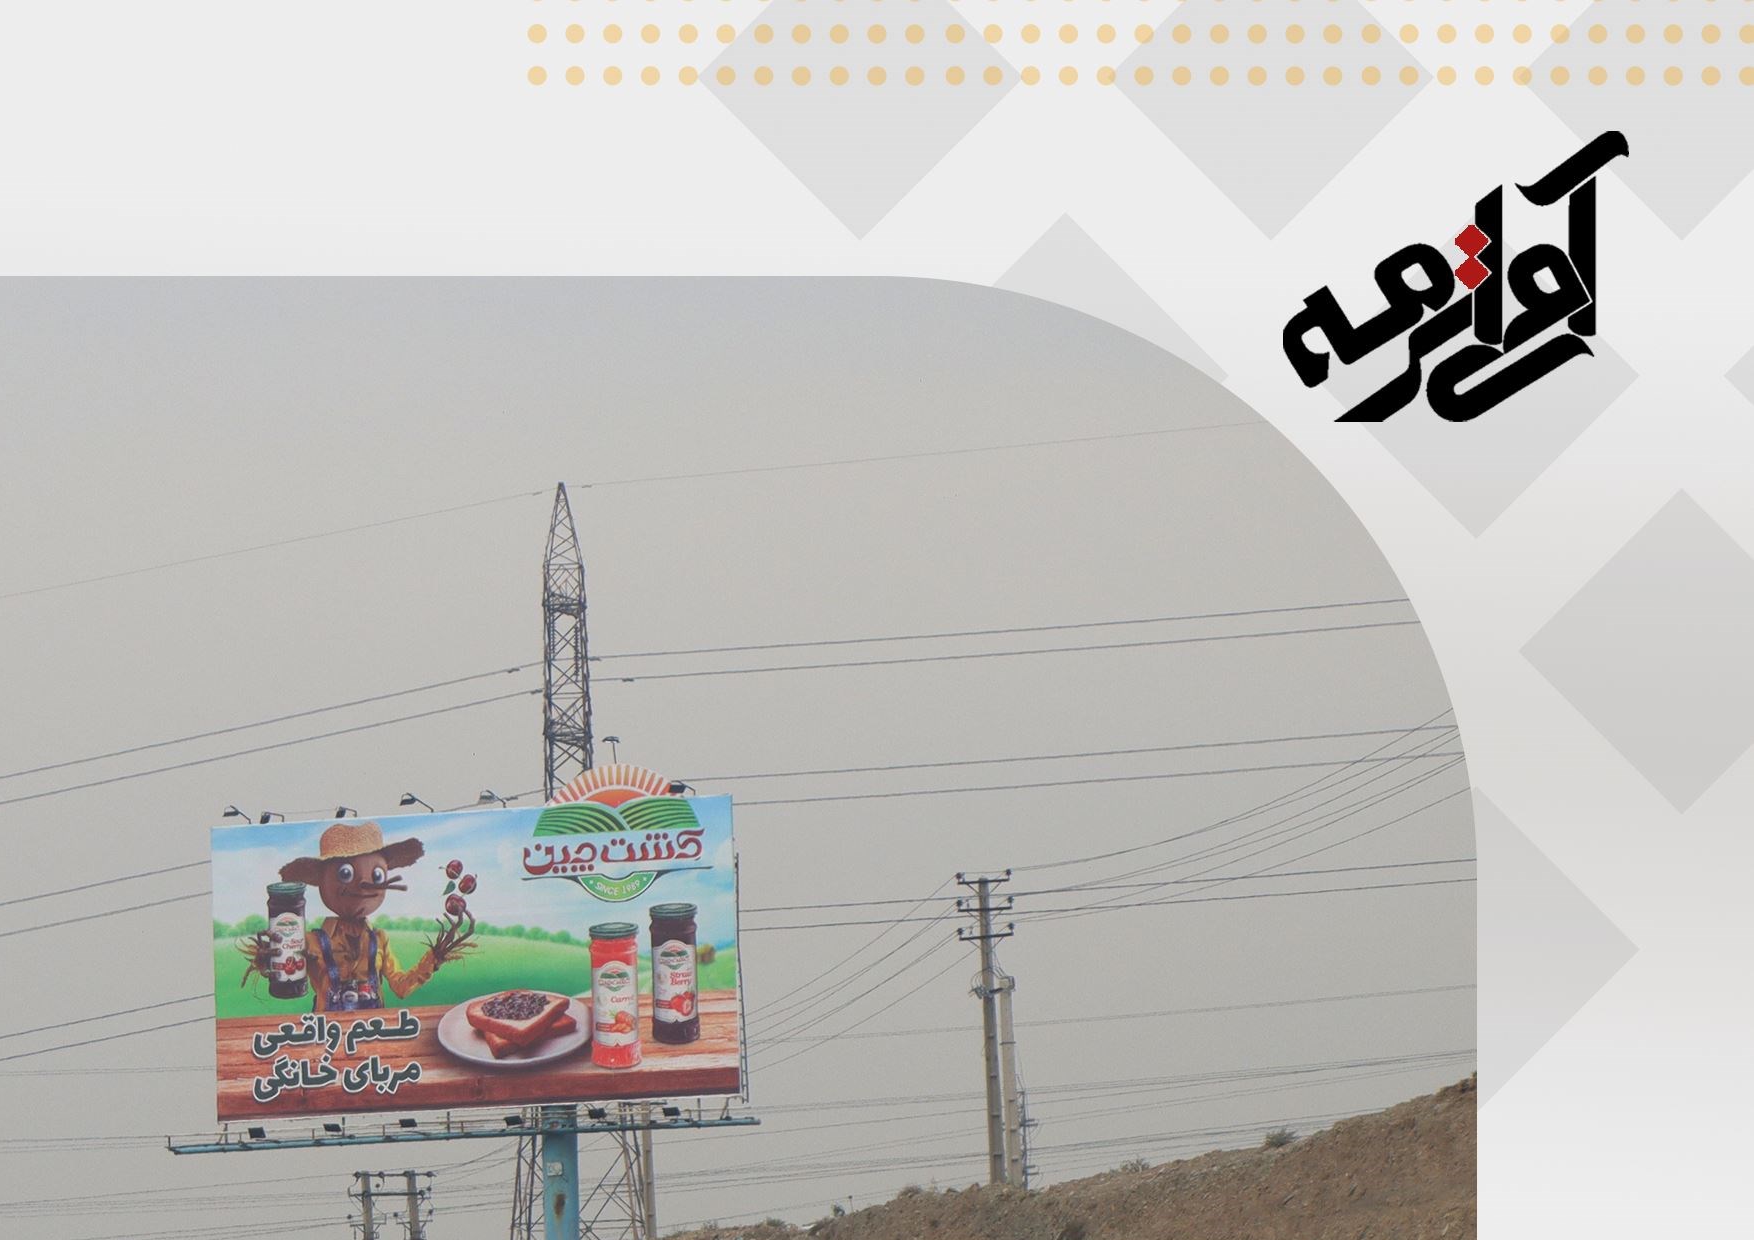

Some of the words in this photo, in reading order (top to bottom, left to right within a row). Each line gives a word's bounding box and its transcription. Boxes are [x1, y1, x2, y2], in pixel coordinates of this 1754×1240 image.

[523, 842, 598, 876] چین
[600, 828, 706, 864] کشت
[595, 882, 619, 897] SINCE
[253, 1013, 342, 1059] واقعی
[346, 1009, 421, 1055] طعم
[253, 1053, 339, 1102] خانگی
[343, 1056, 422, 1094] مربای
